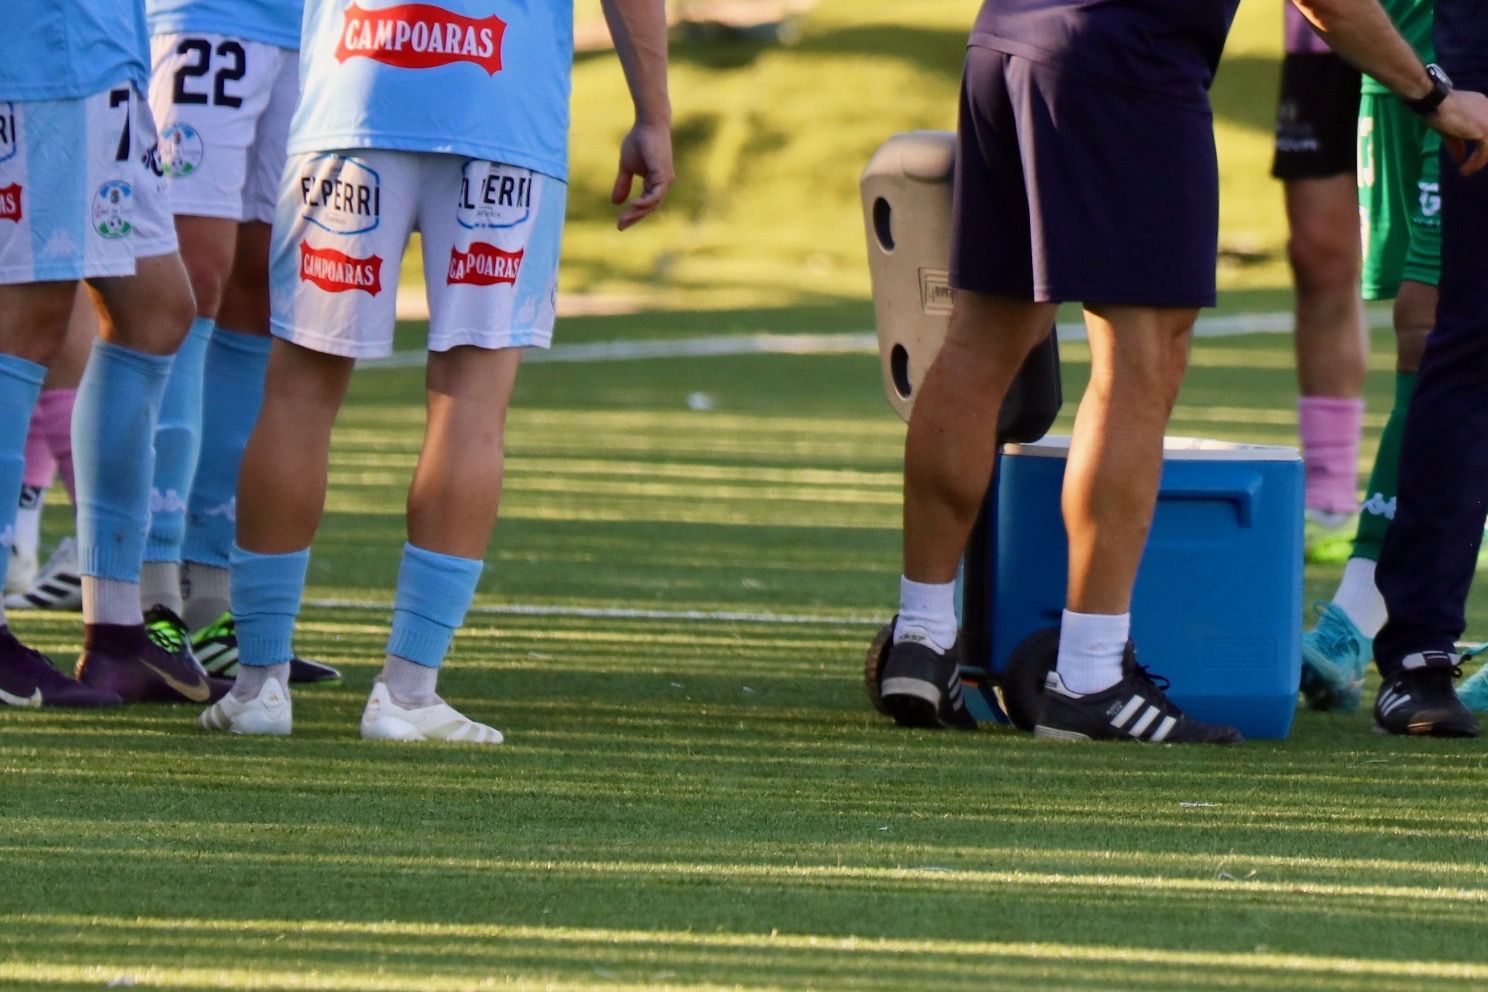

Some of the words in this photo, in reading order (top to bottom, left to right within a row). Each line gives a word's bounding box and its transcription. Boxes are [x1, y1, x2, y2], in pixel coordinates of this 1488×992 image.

[344, 18, 494, 58] CAMPOARAS
[172, 38, 246, 108] 22
[109, 89, 130, 161] 7
[321, 179, 380, 217] PERRI
[303, 254, 375, 287] CAMPOARAS
